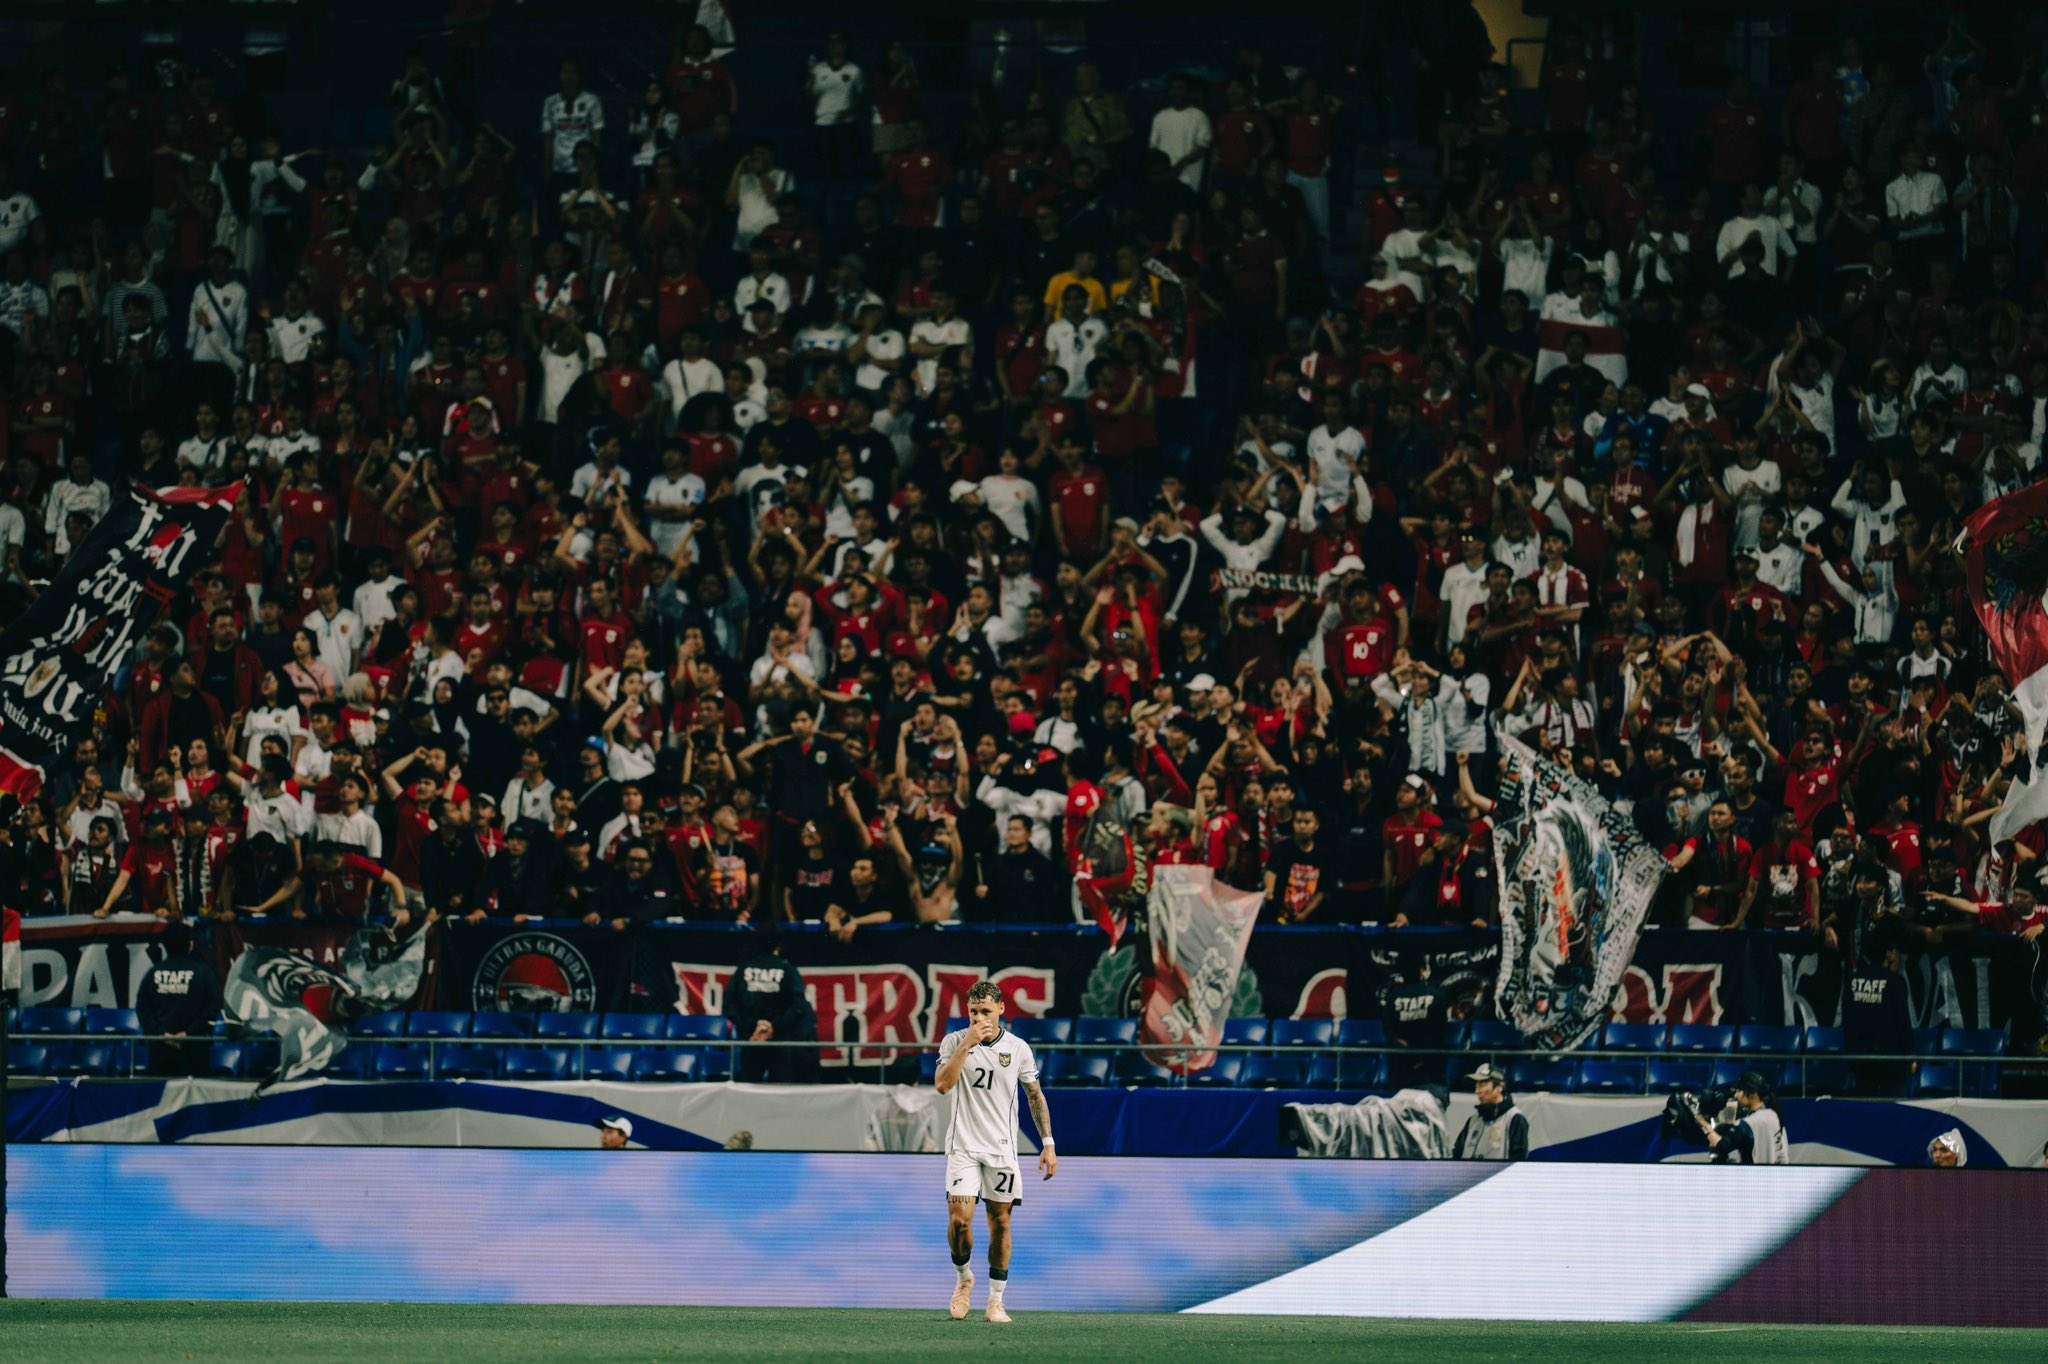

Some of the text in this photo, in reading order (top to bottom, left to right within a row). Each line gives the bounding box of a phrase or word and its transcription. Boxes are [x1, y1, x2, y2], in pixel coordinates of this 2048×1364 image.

[1353, 642, 1369, 660] 10
[153, 969, 194, 985] STAFF
[743, 966, 785, 983] STAFF
[1851, 977, 1887, 993] STAFF
[1394, 994, 1435, 1012] STAFF
[972, 1067, 995, 1091] 21
[994, 1170, 1016, 1194] 21
